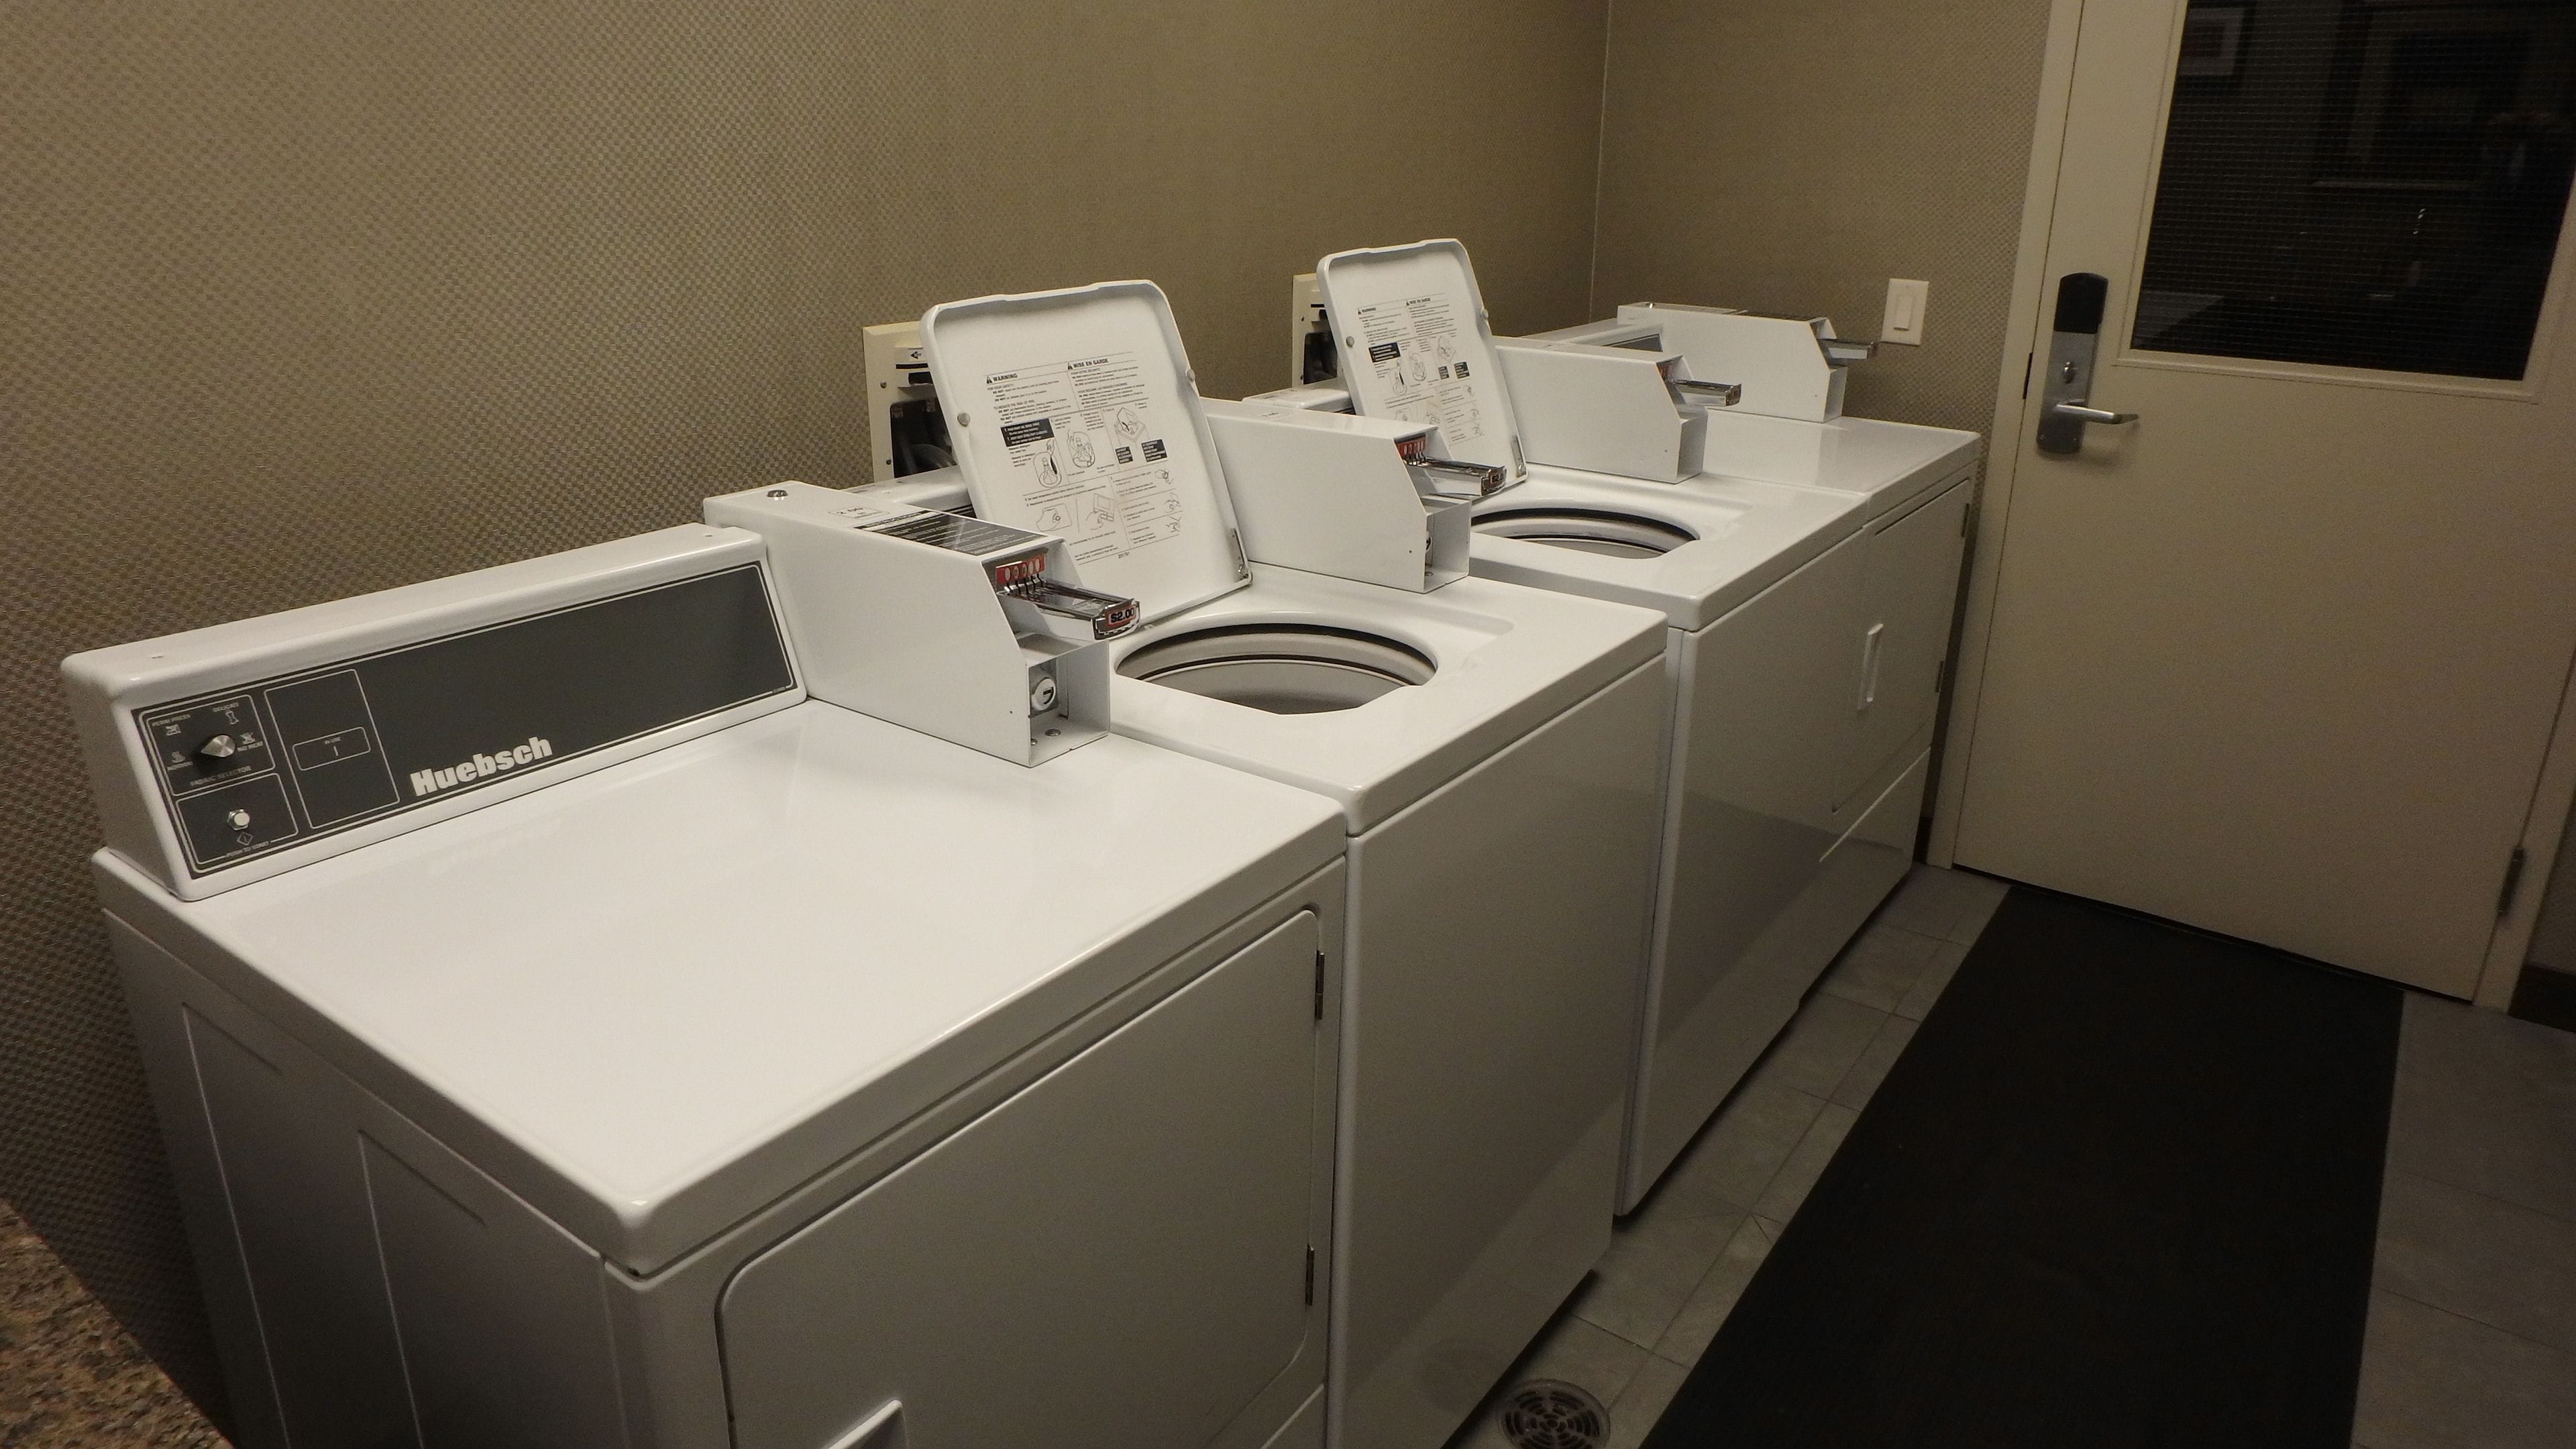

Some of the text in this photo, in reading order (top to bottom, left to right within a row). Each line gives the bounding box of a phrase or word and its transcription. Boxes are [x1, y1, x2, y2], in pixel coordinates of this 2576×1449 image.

[992, 373, 1018, 382] WARNING
[217, 765, 252, 782] SELECTOR
[409, 736, 553, 797] Huebsch
